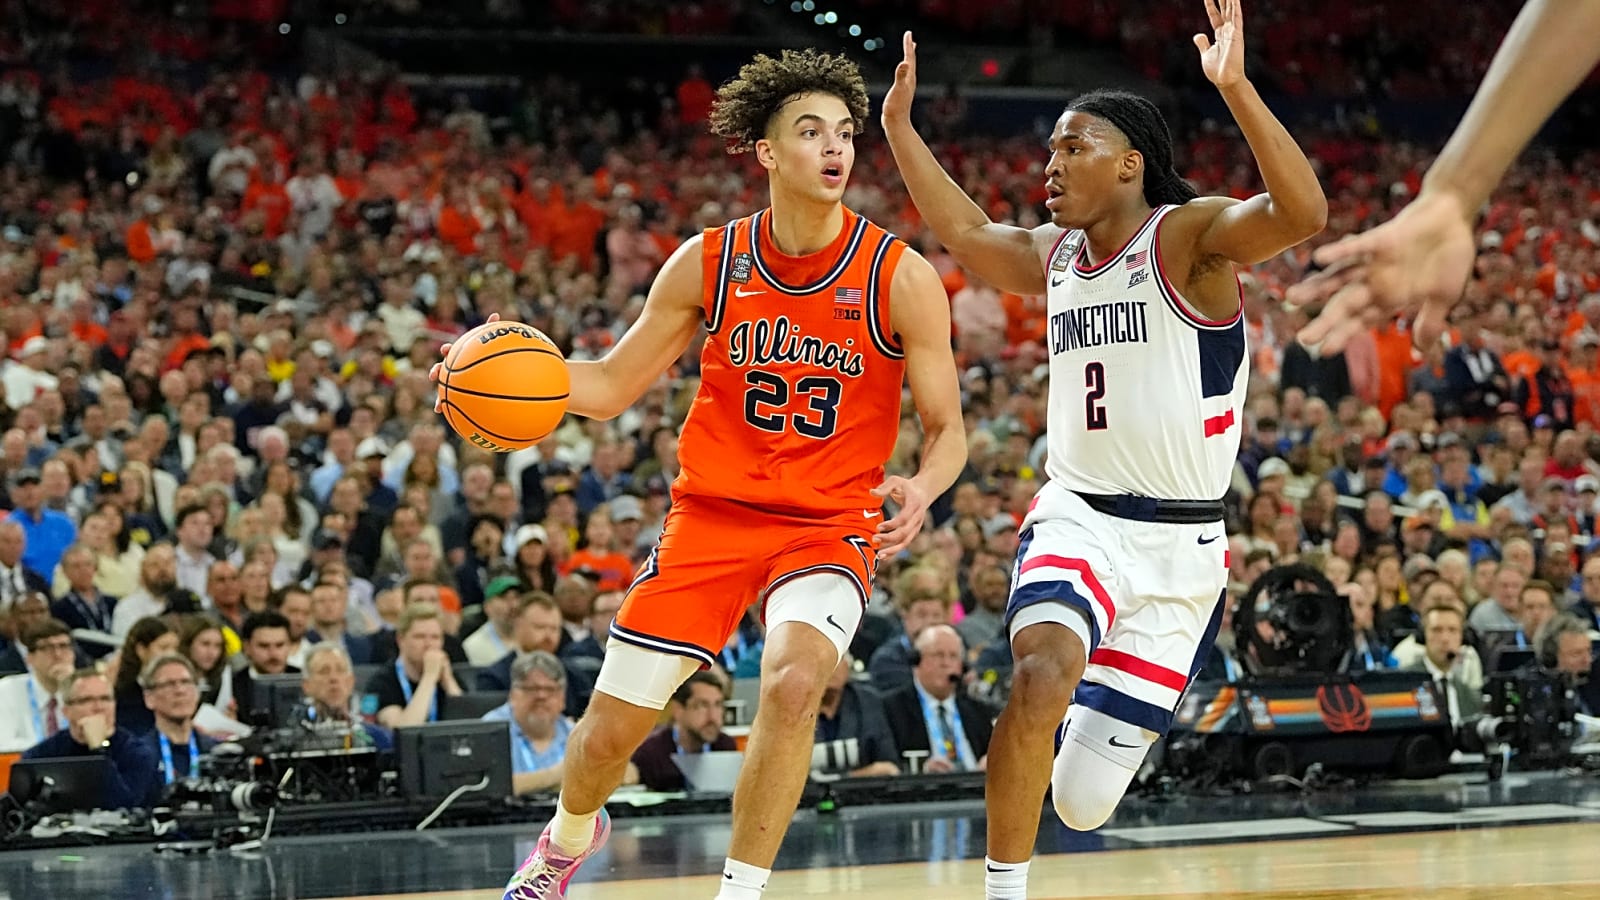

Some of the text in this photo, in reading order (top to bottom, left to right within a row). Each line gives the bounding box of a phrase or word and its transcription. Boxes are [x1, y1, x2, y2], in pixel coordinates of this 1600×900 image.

[731, 270, 748, 279] FOUR
[729, 315, 865, 377] Illinois
[1050, 301, 1148, 356] CONNECTICUT
[743, 369, 843, 440] 23
[1085, 361, 1108, 431] 2
